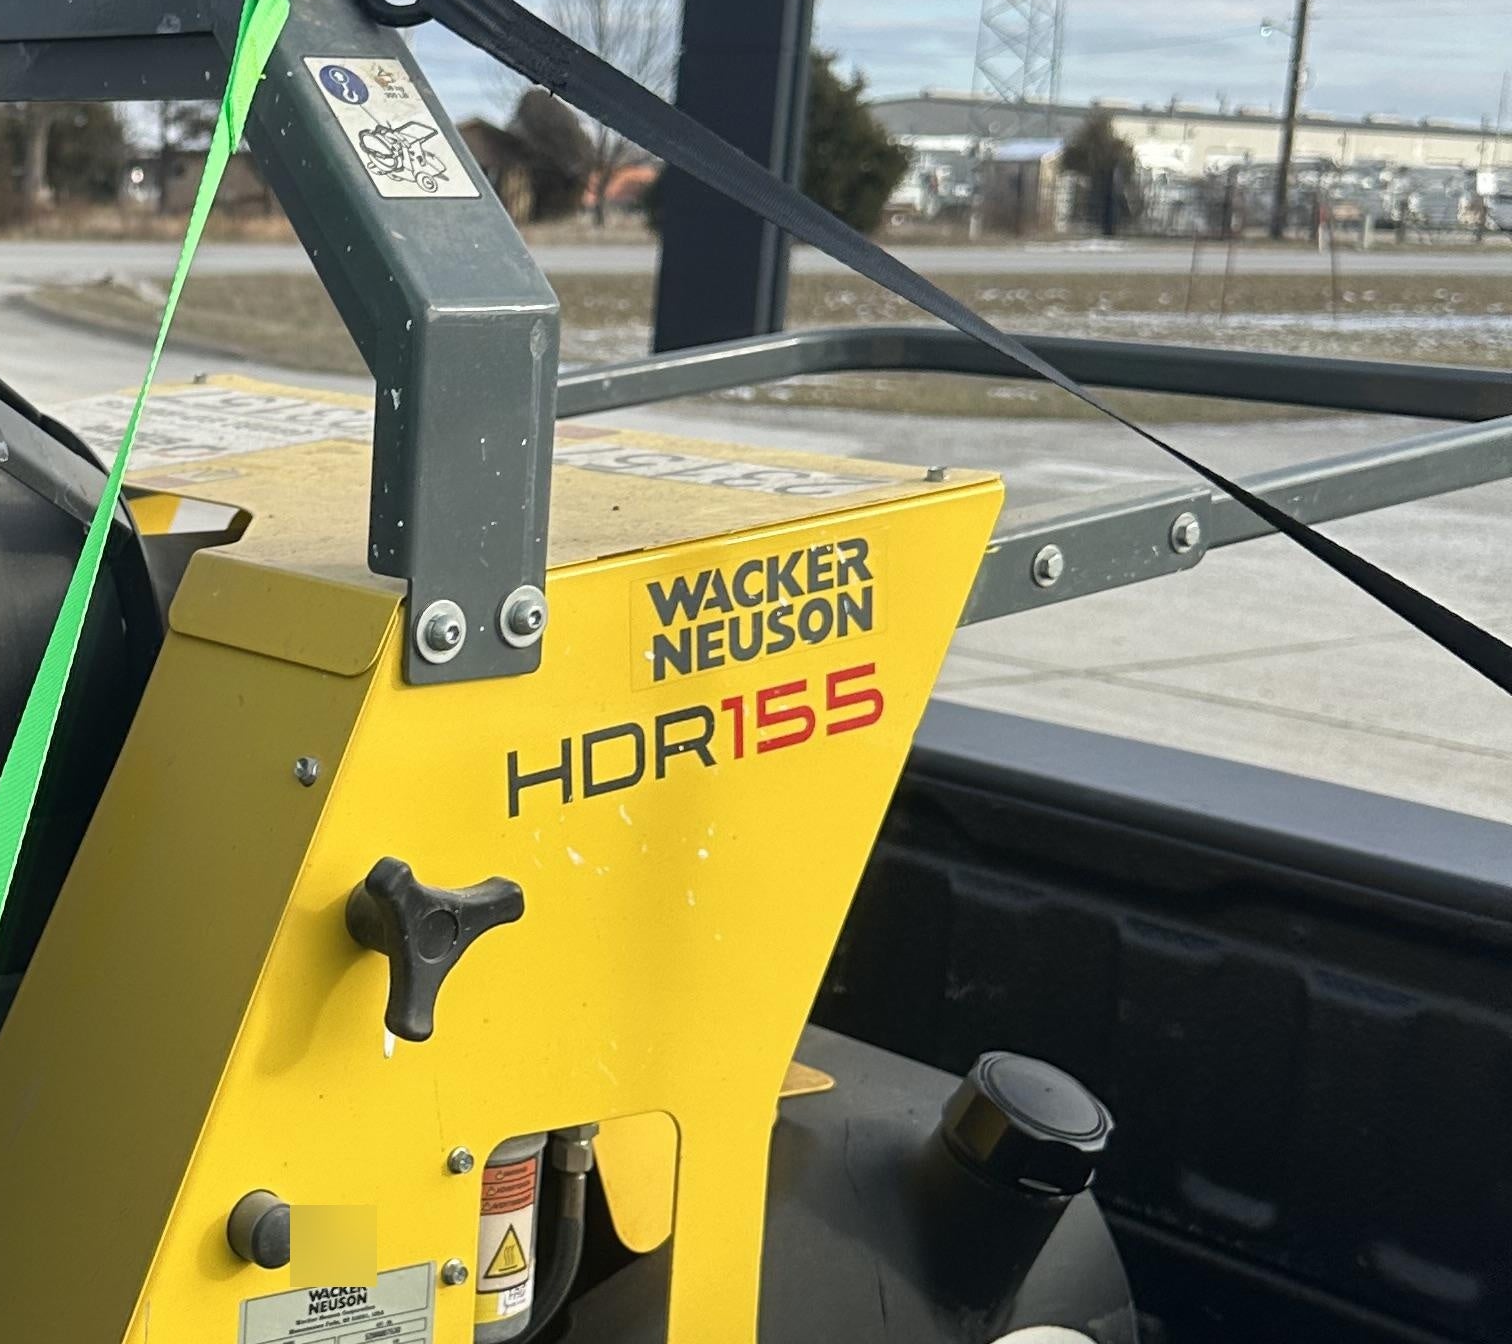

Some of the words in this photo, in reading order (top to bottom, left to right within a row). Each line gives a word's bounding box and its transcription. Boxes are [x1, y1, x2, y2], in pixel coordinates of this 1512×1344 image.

[646, 536, 874, 627] WACKER
[652, 586, 874, 682] NEUSON
[507, 662, 885, 819] HDR155
[308, 1292, 367, 1315] NEUSON
